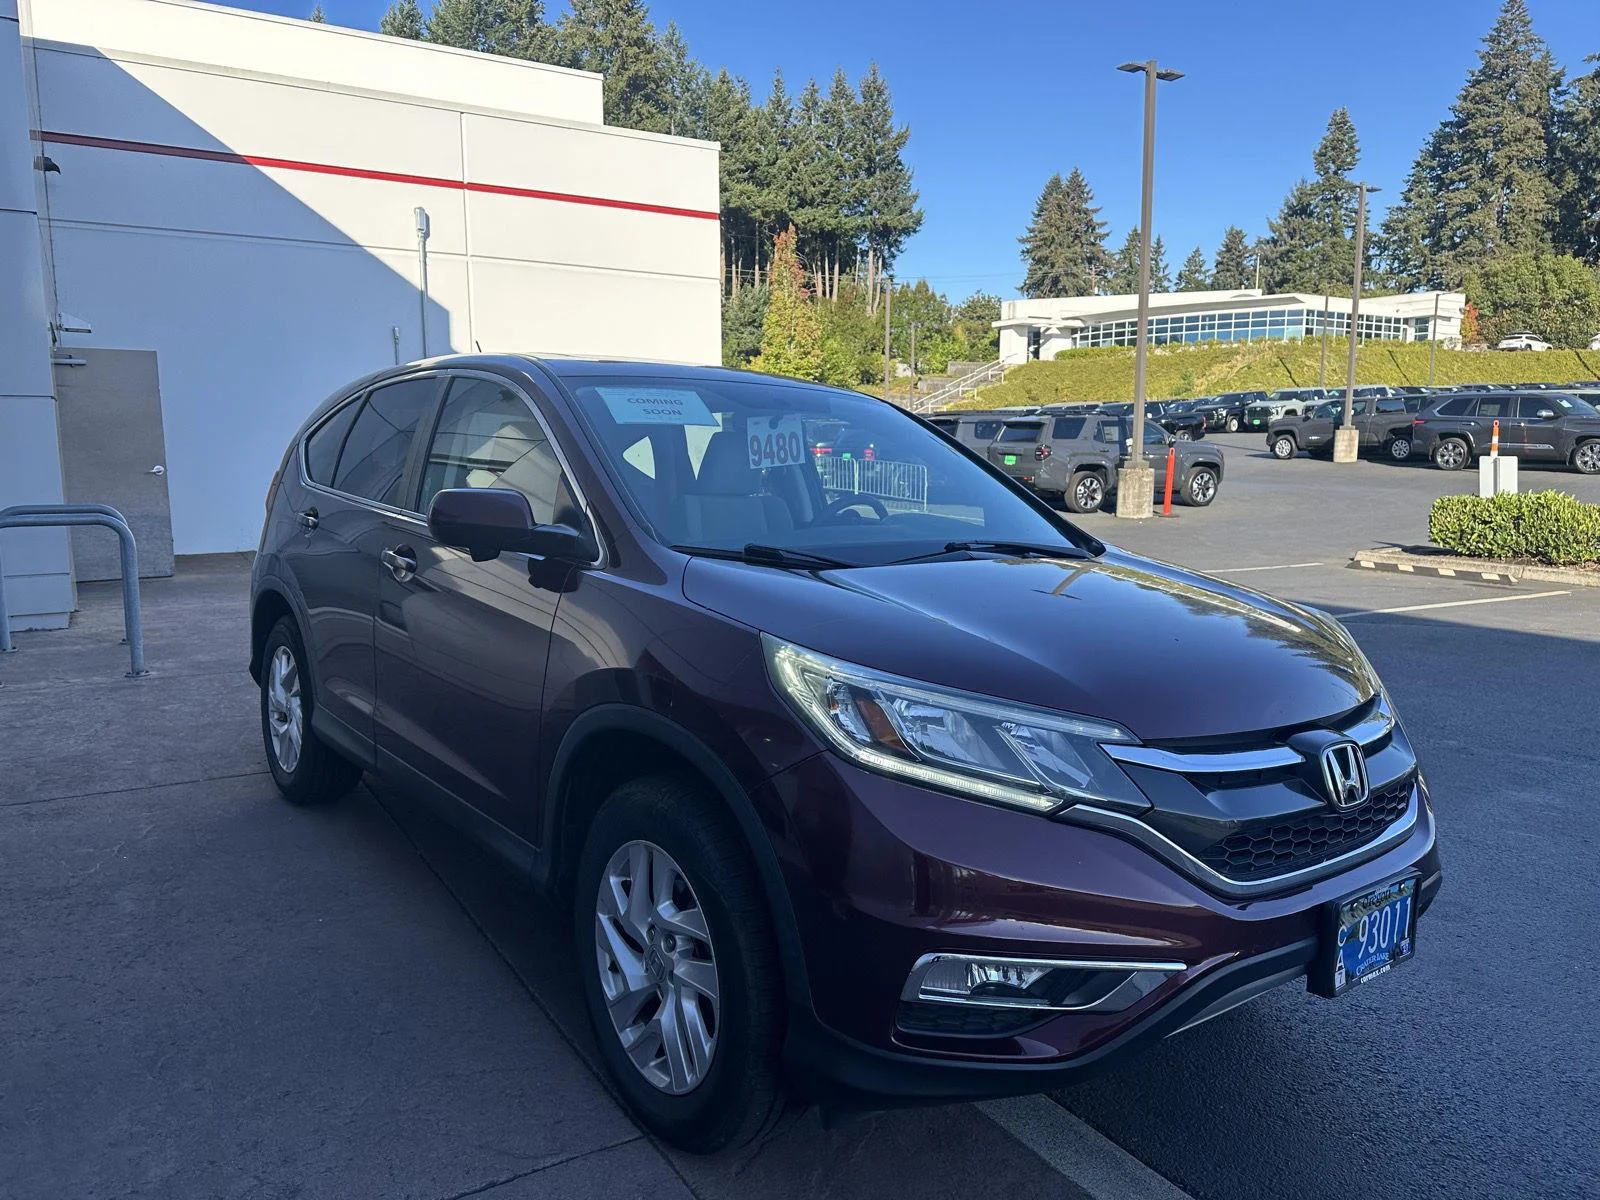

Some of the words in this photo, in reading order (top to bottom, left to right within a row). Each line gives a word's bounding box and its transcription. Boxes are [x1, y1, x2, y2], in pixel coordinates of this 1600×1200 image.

[627, 396, 683, 406] COMING
[643, 407, 683, 416] SOON
[749, 431, 801, 467] 9480
[1358, 897, 1411, 960] 93011
